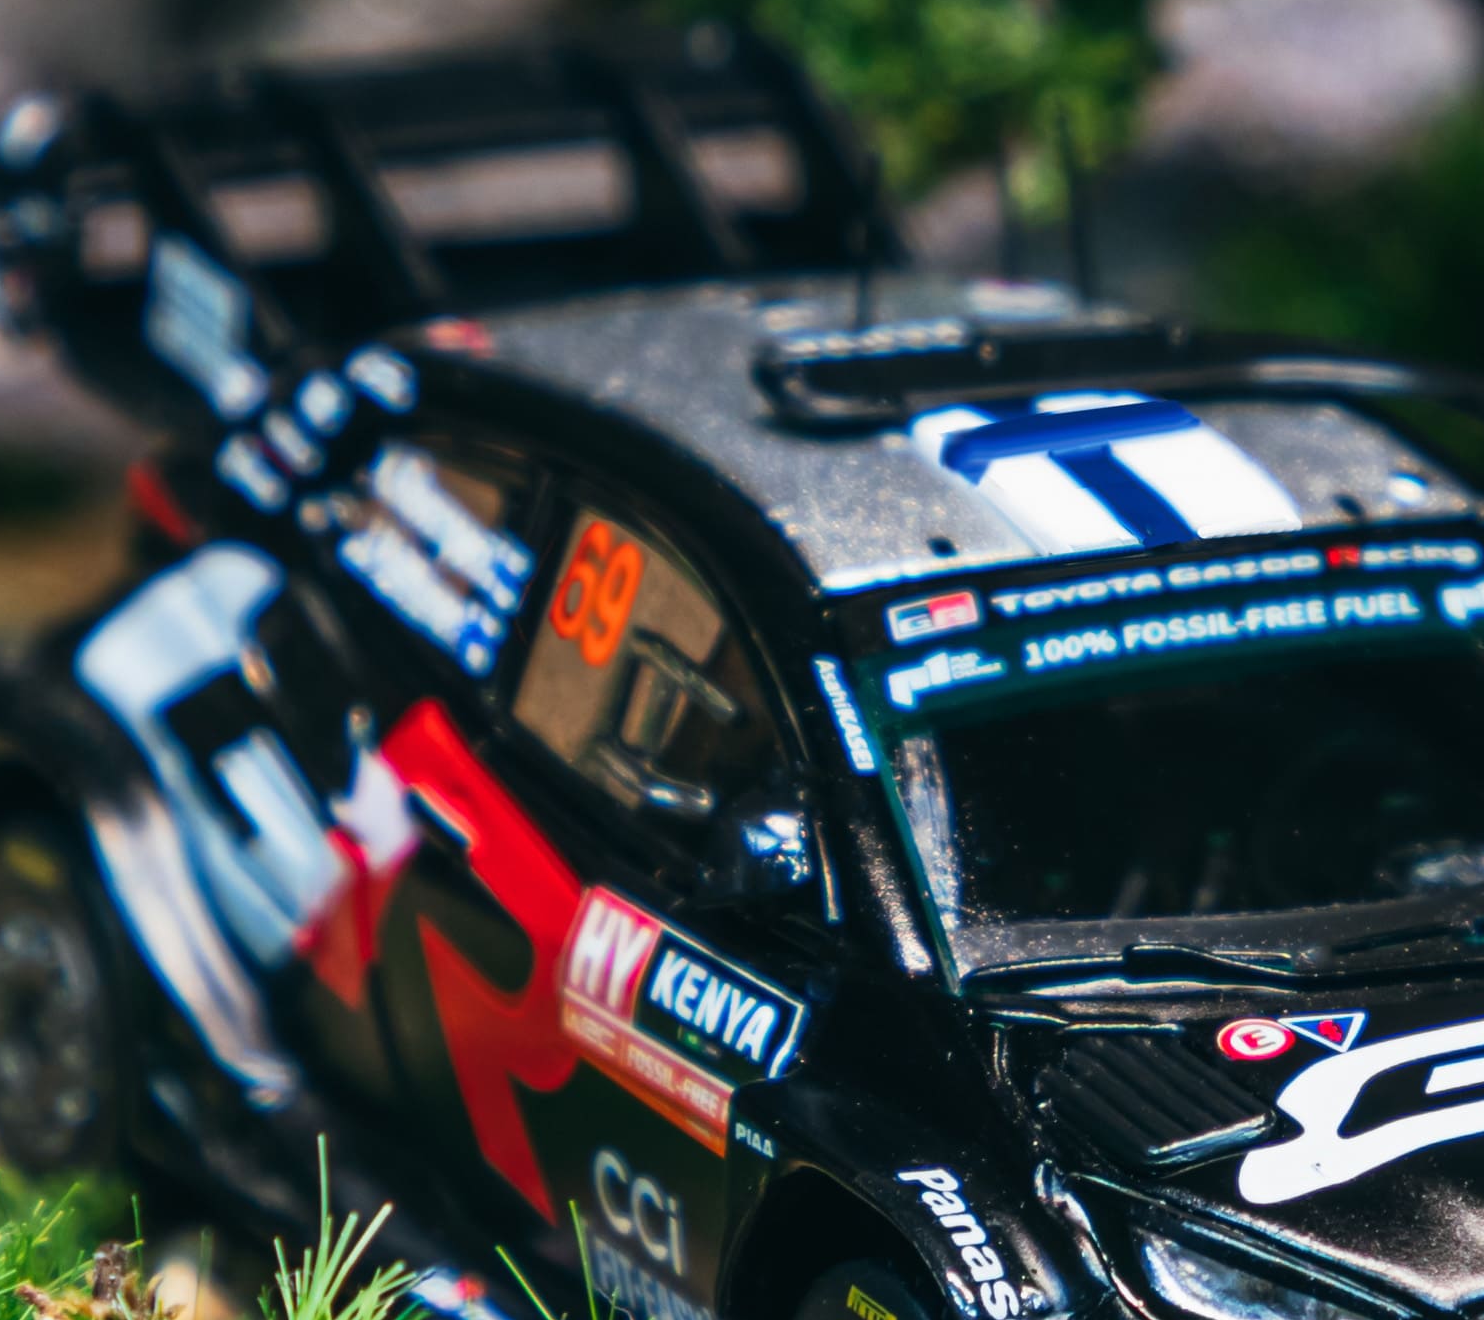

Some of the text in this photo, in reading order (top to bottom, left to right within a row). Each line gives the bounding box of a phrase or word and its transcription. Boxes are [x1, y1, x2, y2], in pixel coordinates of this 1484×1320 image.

[550, 521, 644, 666] 69
[991, 573, 1162, 613] TOYOTA
[1168, 555, 1320, 585] GAZOO
[1026, 630, 1117, 668] 100%
[1123, 600, 1327, 649] FOSSIL-FREE
[1334, 592, 1419, 621] FUEL
[649, 949, 776, 1063] KENYA
[735, 1122, 775, 1159] PIAA
